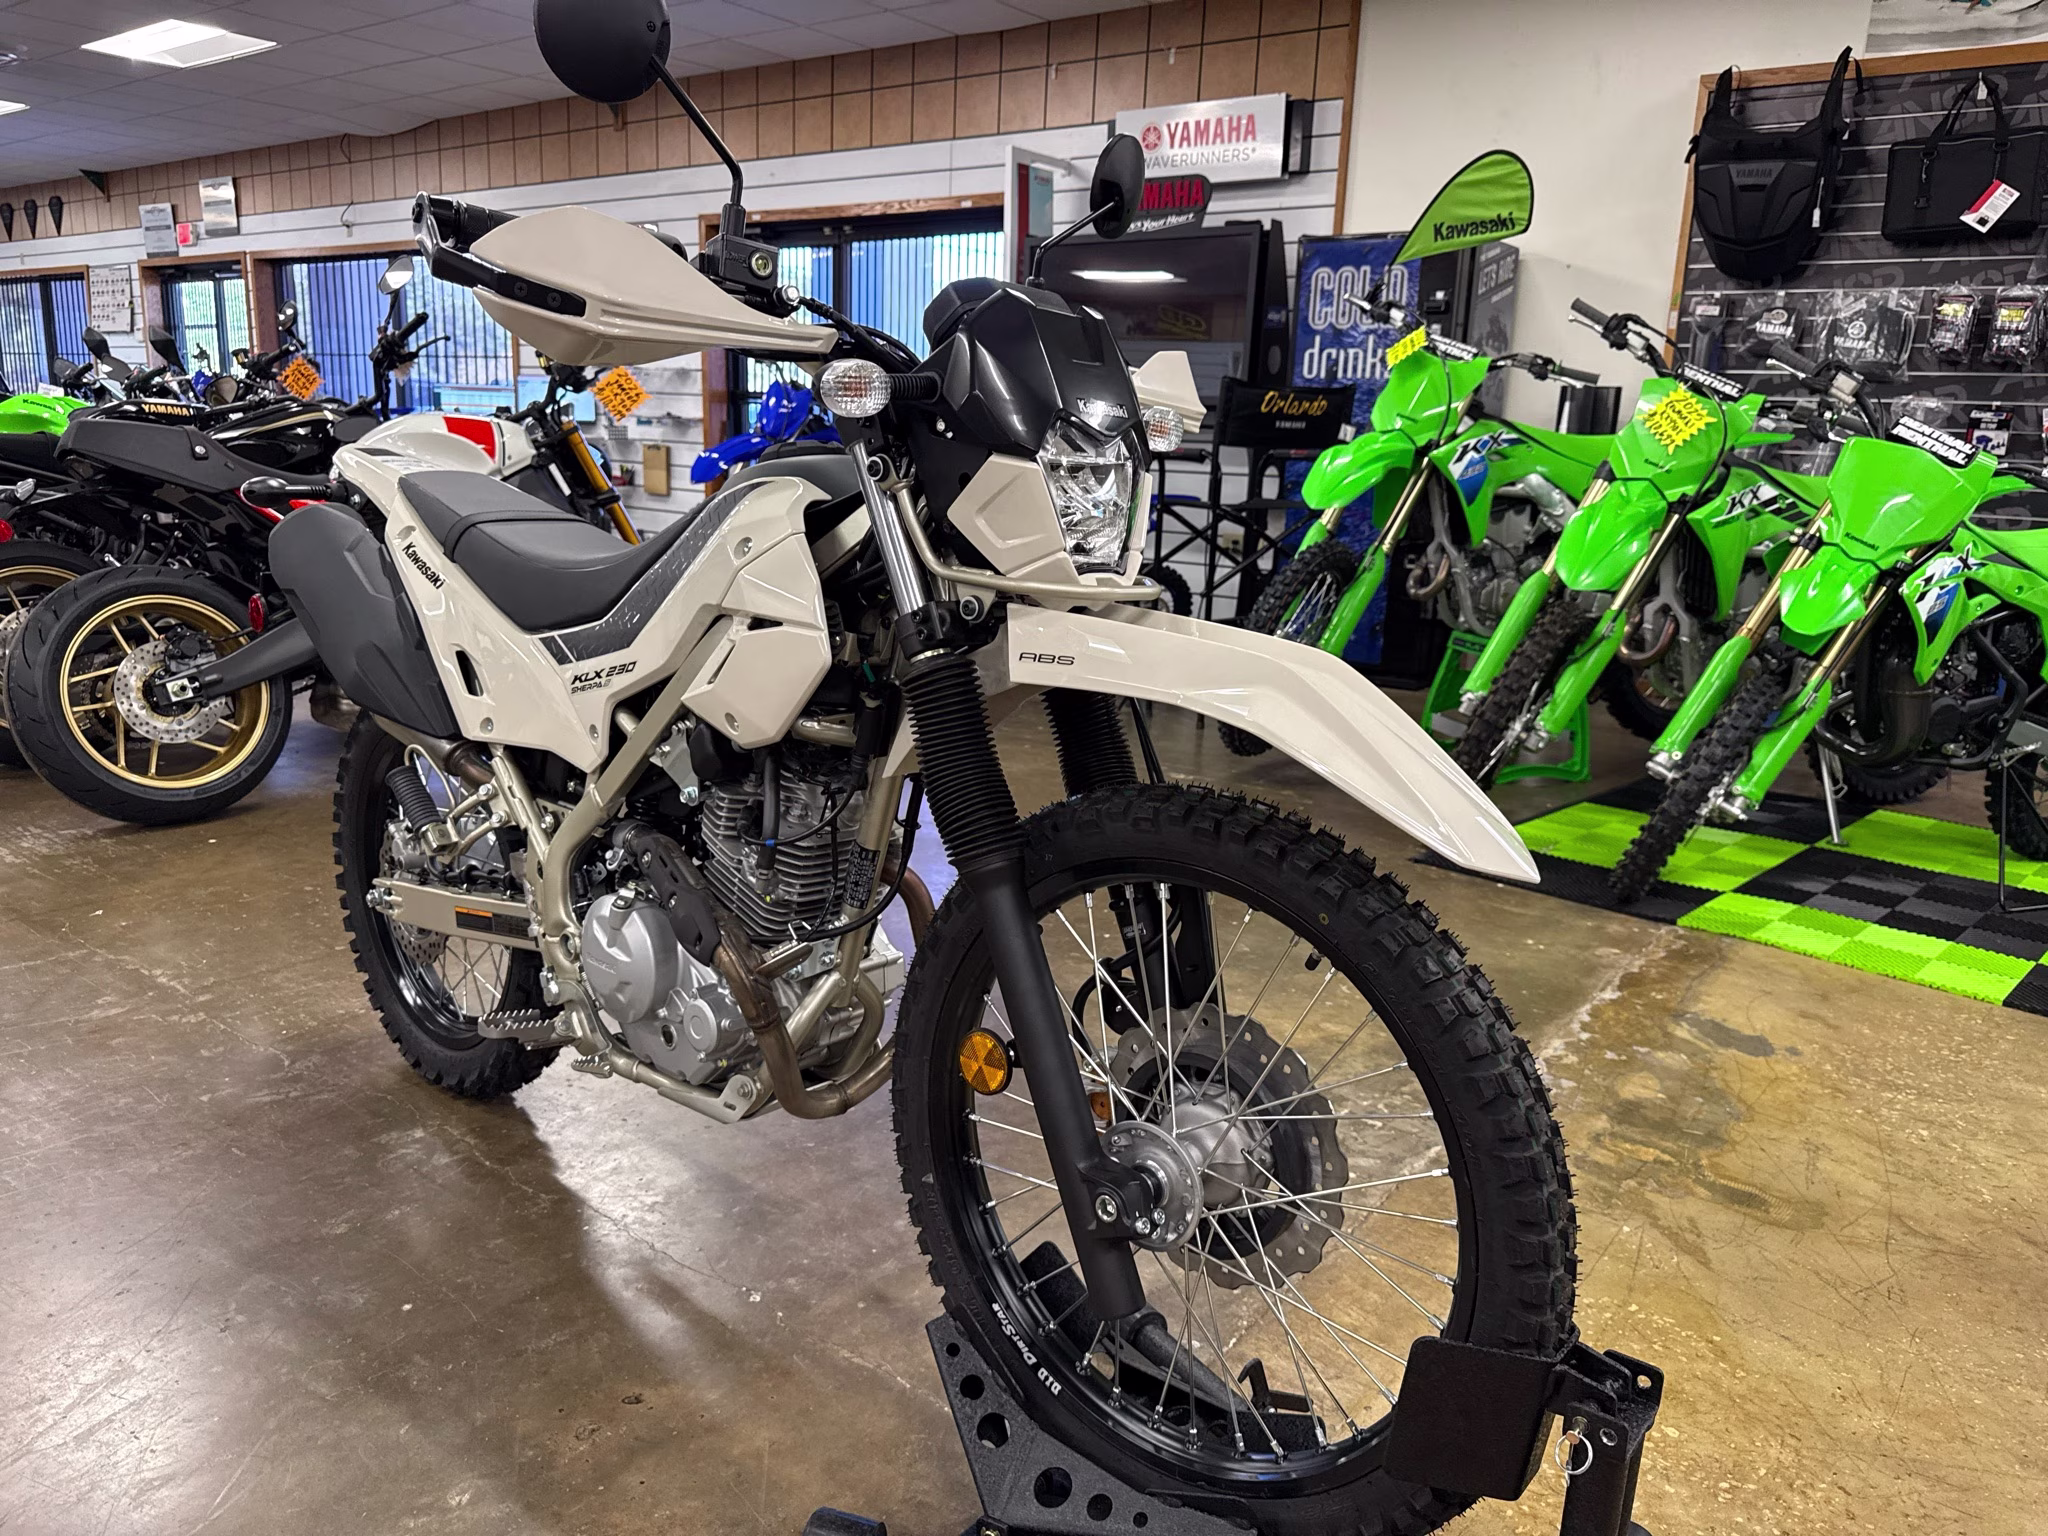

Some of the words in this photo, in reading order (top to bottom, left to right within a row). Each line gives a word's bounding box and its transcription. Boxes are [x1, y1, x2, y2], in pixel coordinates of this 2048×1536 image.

[1166, 114, 1257, 149] YAMAHA
[1736, 168, 1772, 179] YAMAHA
[1138, 179, 1205, 211] MAHA
[1433, 211, 1516, 242] Kawasaki
[1308, 265, 1409, 329] COLD
[1303, 335, 1391, 379] drink
[141, 403, 190, 417] YAMAHA
[1260, 390, 1328, 416] Orlando
[1674, 395, 1704, 419] 2025
[1453, 430, 1505, 465] KX
[1891, 424, 1968, 465] RENTHAL
[1899, 415, 1975, 454] RENTHAL
[1725, 484, 1762, 516] KX
[402, 542, 445, 590] Kawasaki
[571, 668, 606, 686] KLX
[605, 661, 638, 678] 230
[1019, 652, 1075, 666] ABS
[571, 681, 602, 694] SHERPA
